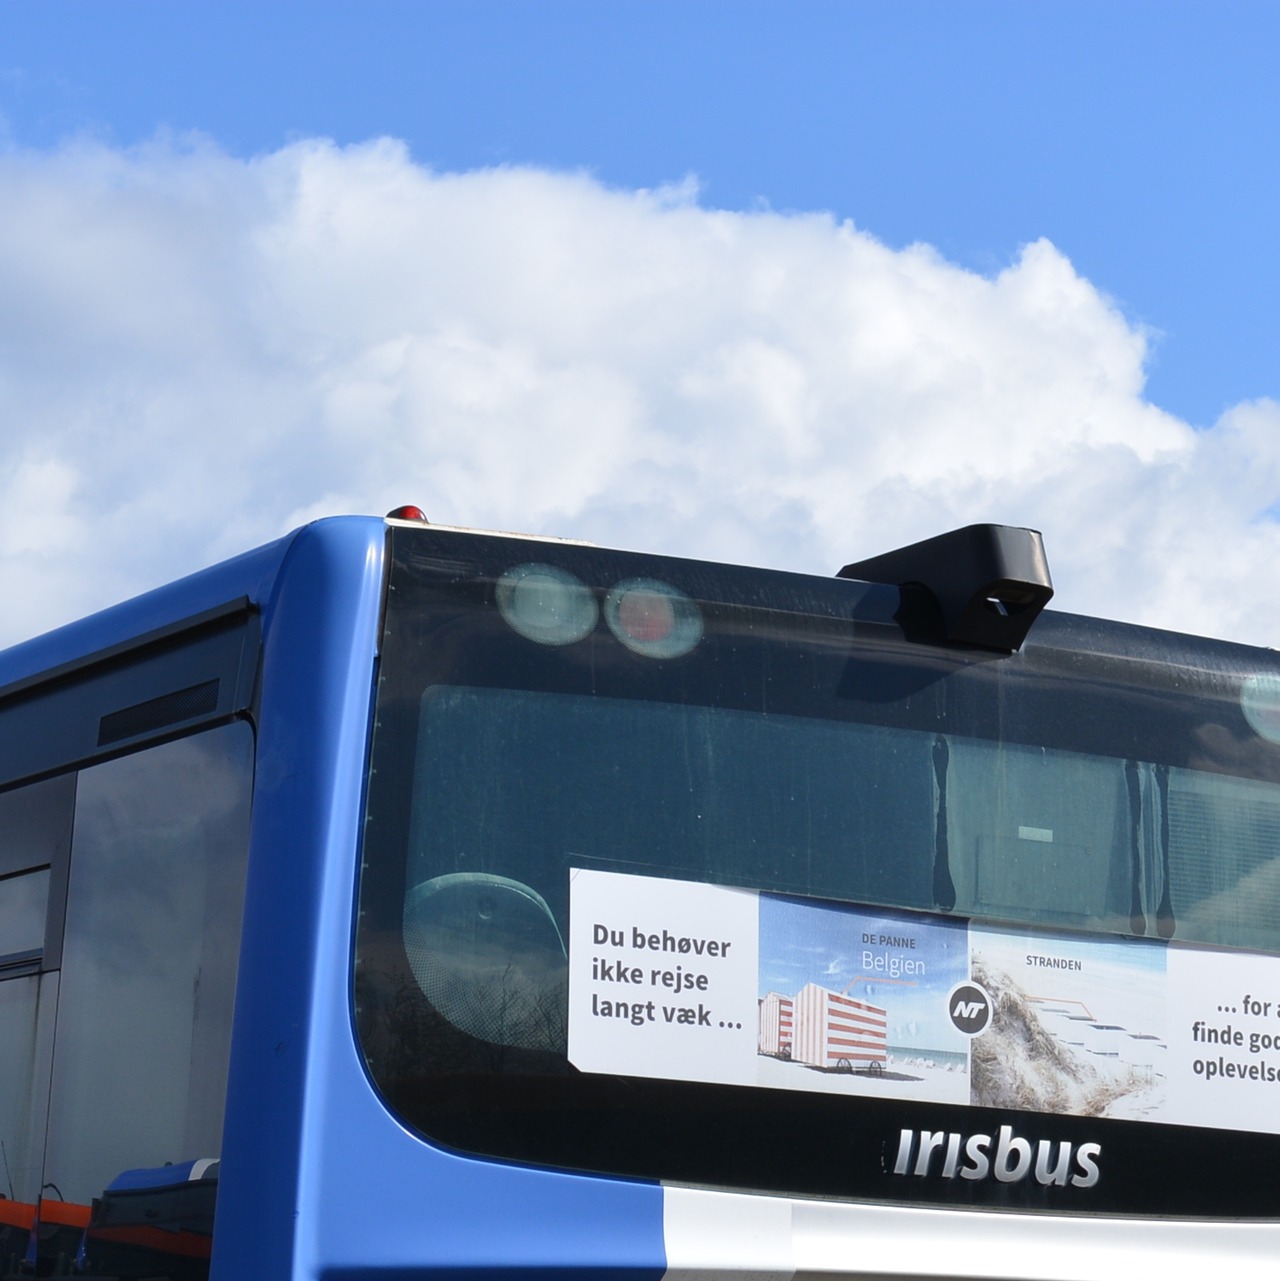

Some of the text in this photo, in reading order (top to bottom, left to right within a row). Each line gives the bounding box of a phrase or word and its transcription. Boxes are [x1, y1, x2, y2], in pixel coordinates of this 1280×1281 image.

[593, 924, 731, 958] Du behøver
[862, 933, 916, 949] DE PANNE
[592, 957, 709, 993] ikke rejse
[862, 951, 925, 978] Belgien
[1026, 955, 1082, 971] STRANDEN
[592, 994, 655, 1026] langt
[662, 1004, 712, 1027] væk
[1242, 994, 1271, 1017] for
[1192, 1021, 1244, 1046] finde
